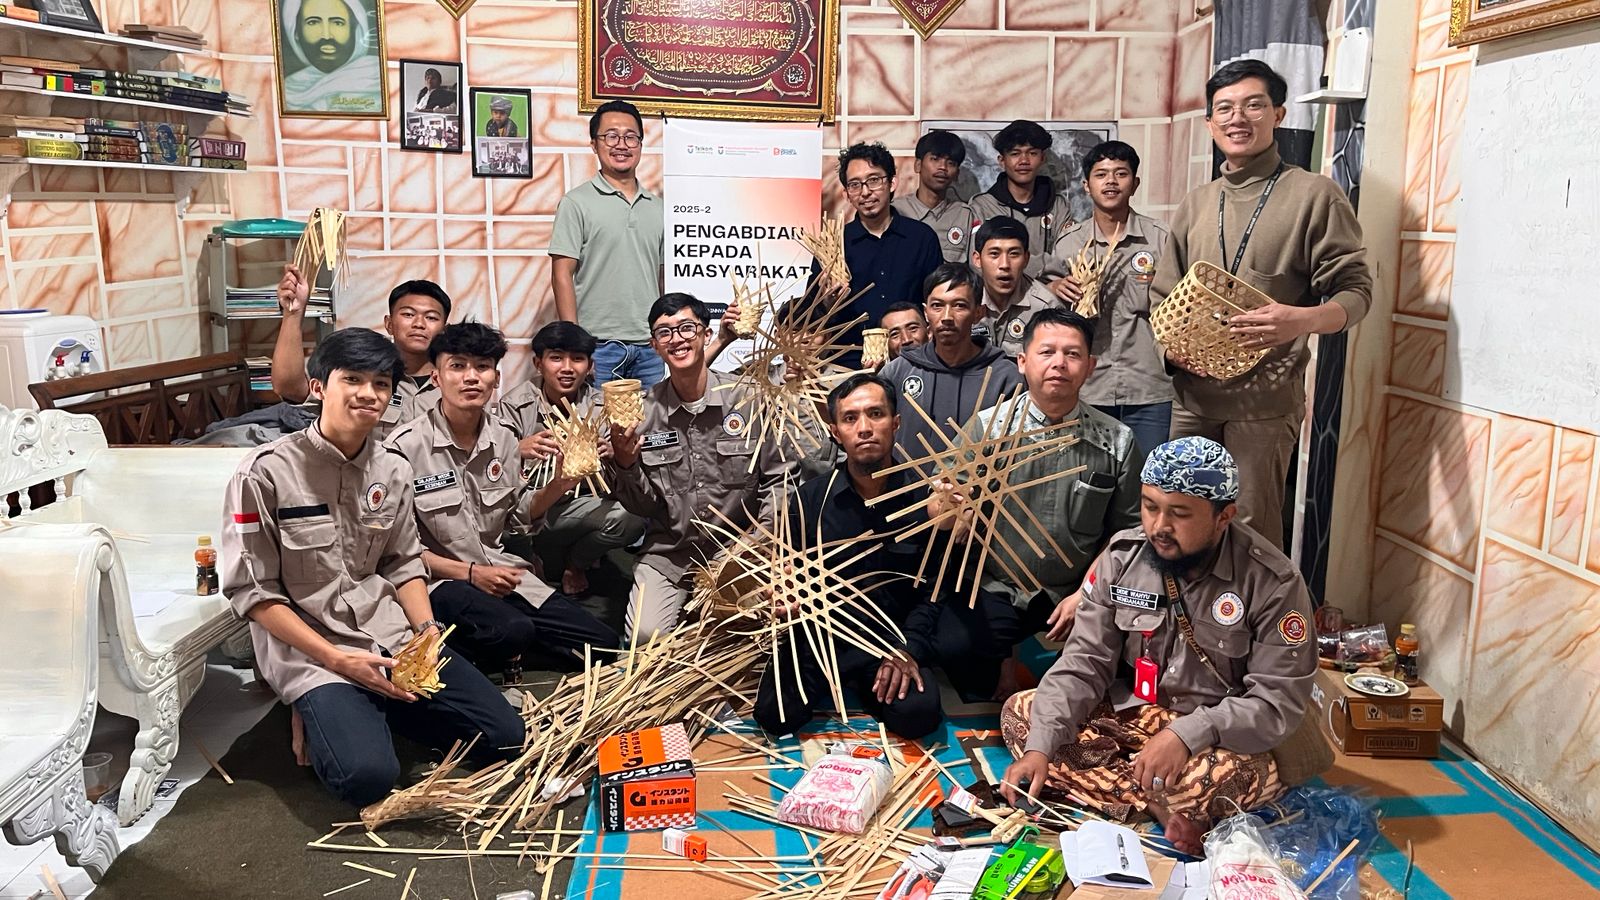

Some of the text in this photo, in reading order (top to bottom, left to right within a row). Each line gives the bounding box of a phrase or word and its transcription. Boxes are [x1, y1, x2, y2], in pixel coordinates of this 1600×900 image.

[673, 205, 711, 214] 2025-2
[673, 224, 804, 240] PENGABDIAN
[674, 244, 753, 259] KEPADA
[674, 263, 810, 279] MASYARAKAT
[608, 762, 687, 781] インスタント
[818, 763, 863, 775] DRAGON
[650, 787, 690, 797] インスタント
[609, 787, 618, 831] インスタント
[1021, 857, 1039, 873] SAW
[1005, 872, 1026, 896] RUNE
